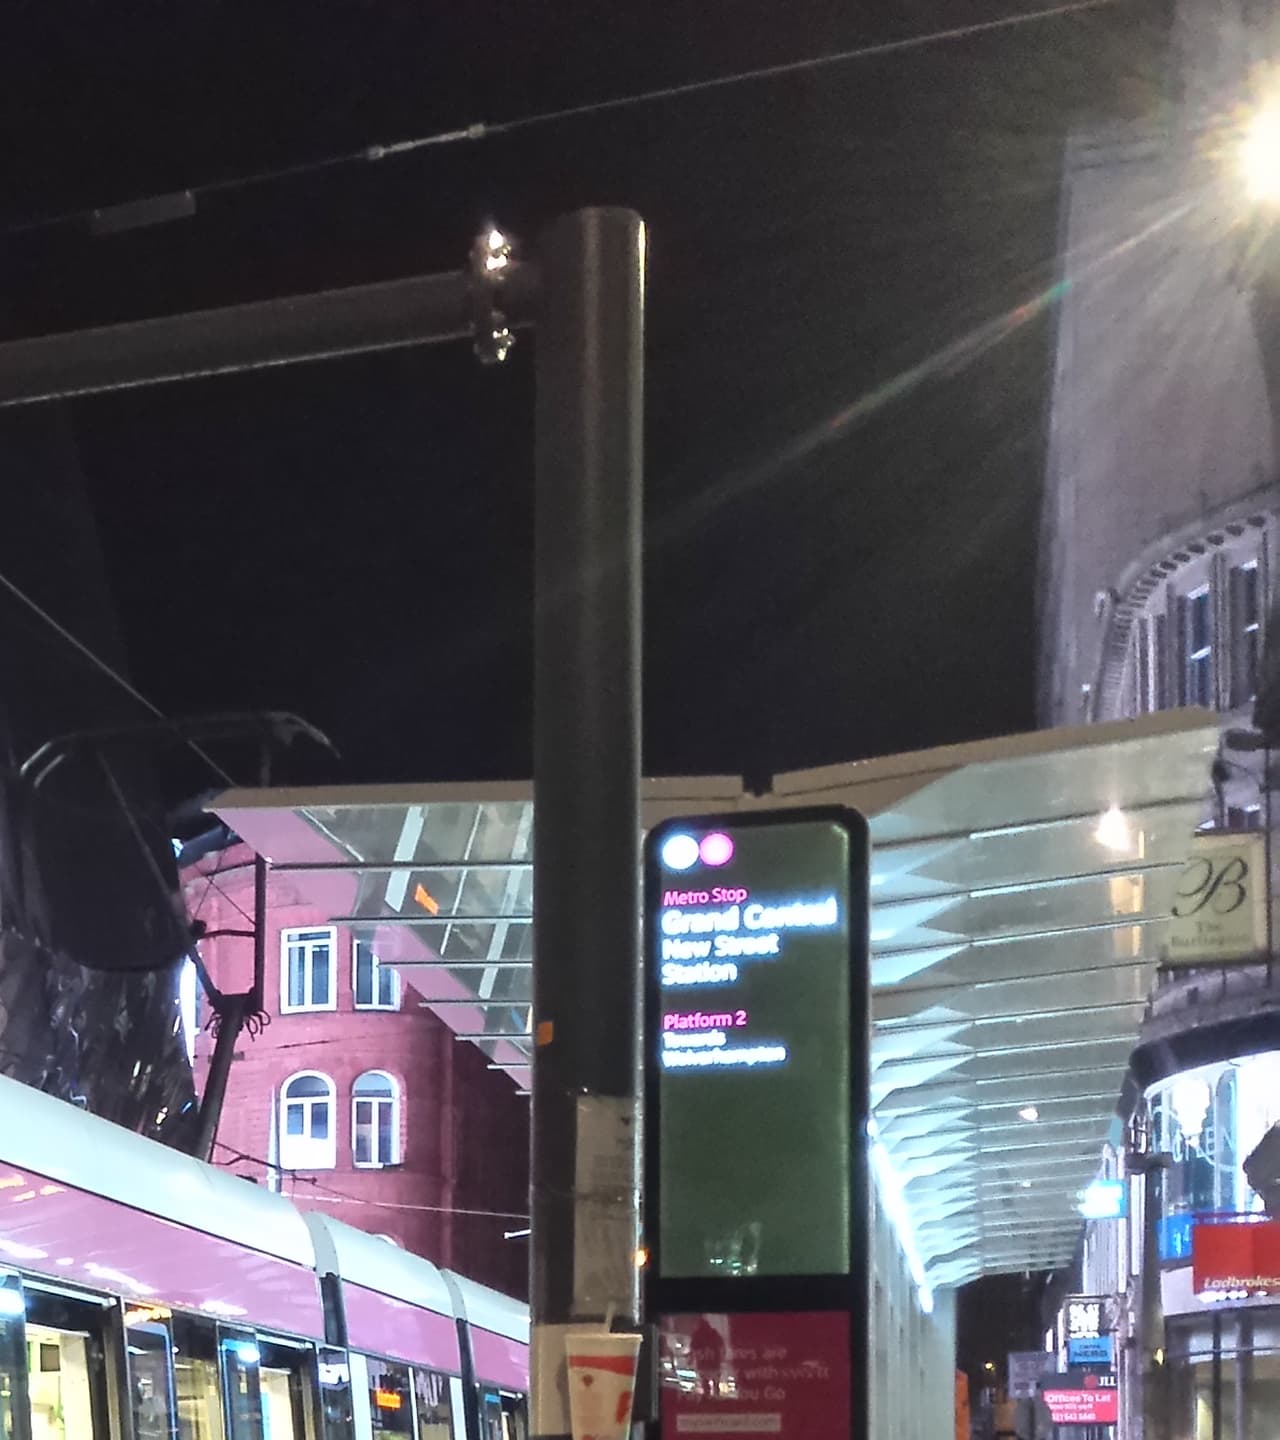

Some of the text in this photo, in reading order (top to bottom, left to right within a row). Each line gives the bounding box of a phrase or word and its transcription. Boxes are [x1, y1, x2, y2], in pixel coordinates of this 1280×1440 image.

[663, 887, 748, 906] Metro Stop
[661, 905, 740, 935] Grand
[662, 938, 712, 960] New
[661, 962, 738, 985] Station
[663, 1010, 747, 1030] Platform 2
[1204, 1275, 1280, 1289] Ladbrokes
[1098, 1376, 1116, 1387] JLL
[764, 1385, 786, 1400] Go
[1082, 1393, 1094, 1402] To
[1095, 1393, 1111, 1402] Let
